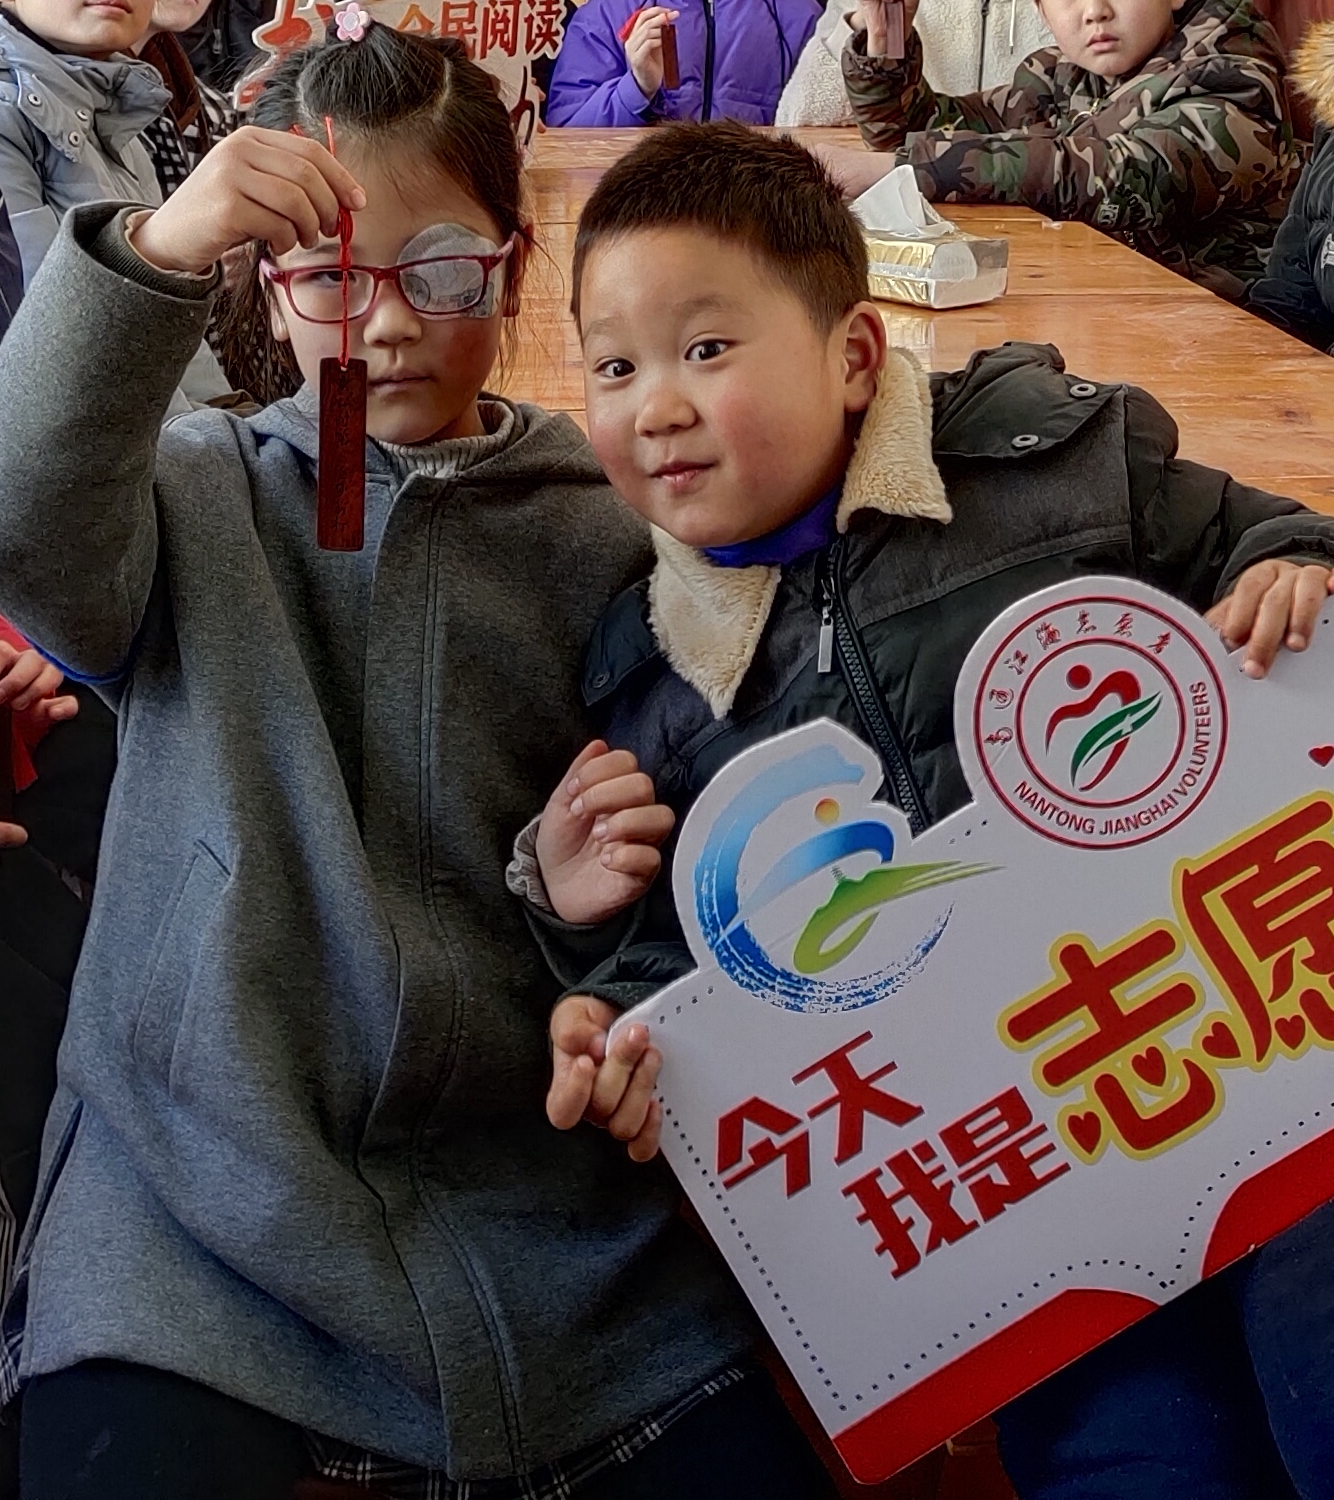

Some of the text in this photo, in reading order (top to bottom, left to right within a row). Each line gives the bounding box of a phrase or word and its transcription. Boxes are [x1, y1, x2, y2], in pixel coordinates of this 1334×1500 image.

[1013, 680, 1212, 836] NANTONG JIANGHAI VOLUNTEERS
[713, 1029, 924, 1199] 今天
[841, 1085, 1073, 1279] 我是
